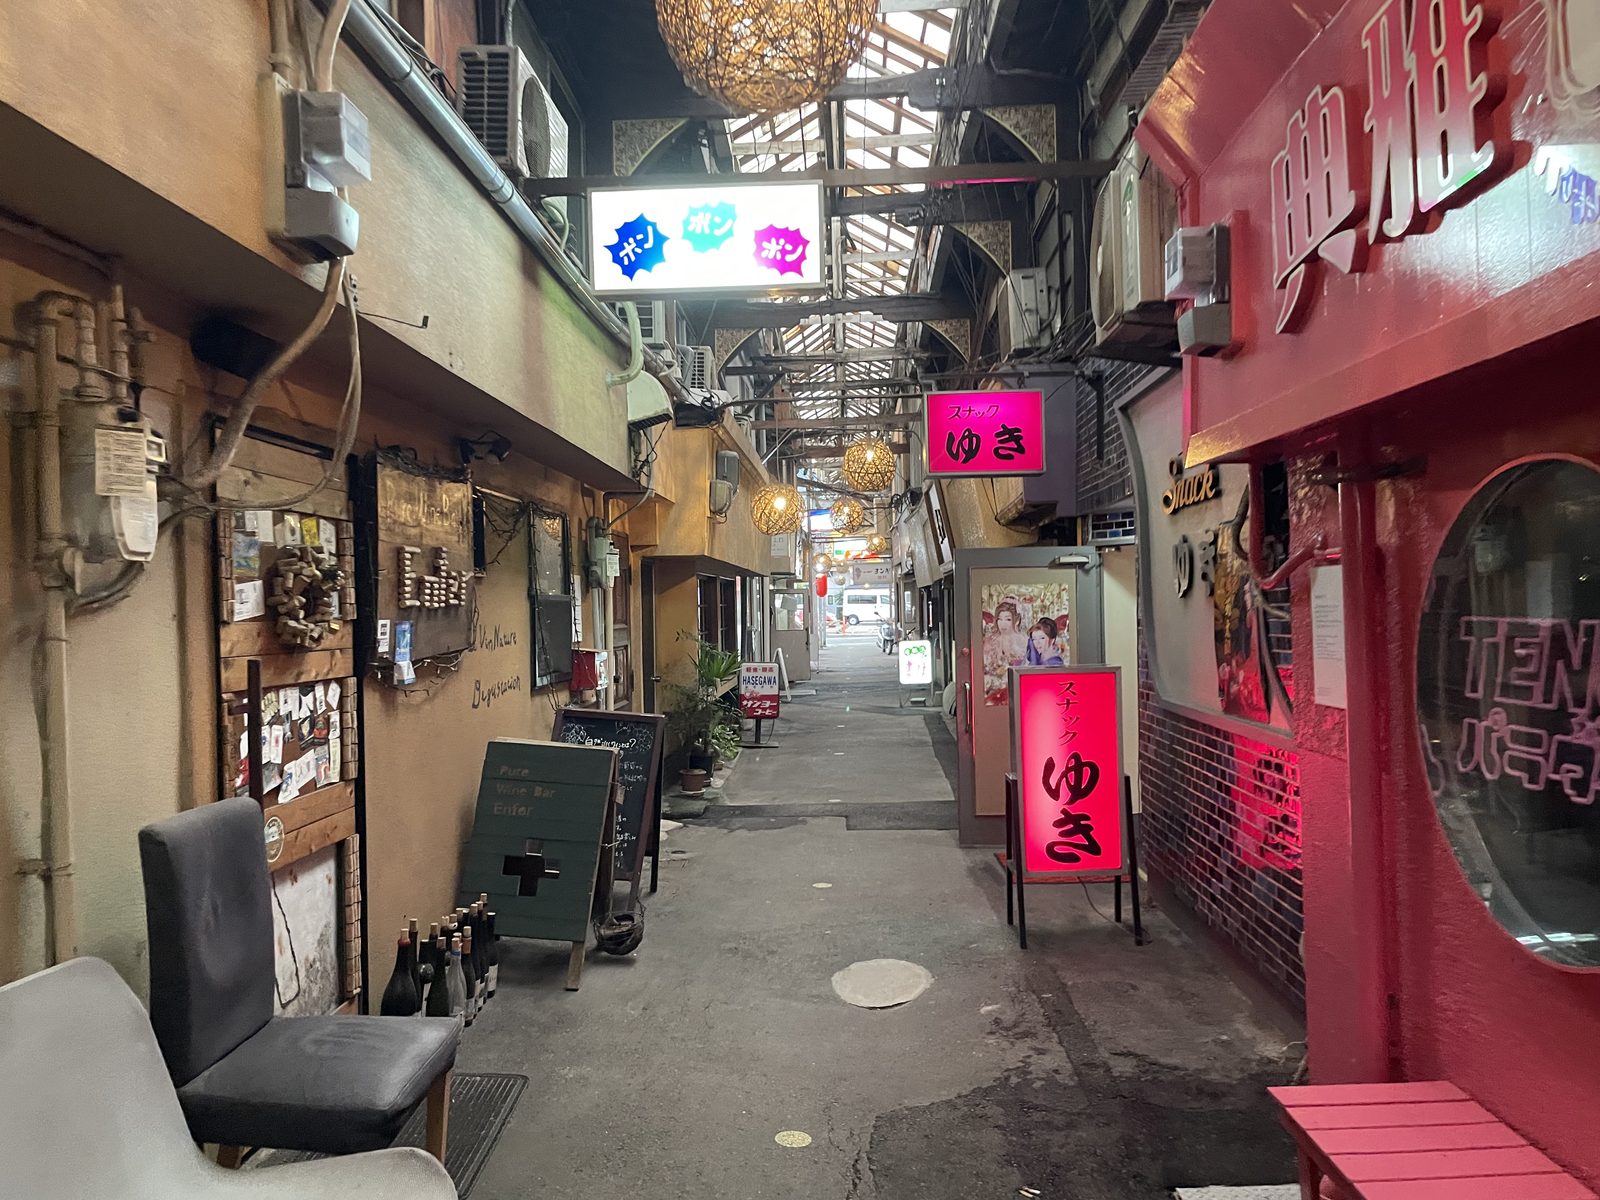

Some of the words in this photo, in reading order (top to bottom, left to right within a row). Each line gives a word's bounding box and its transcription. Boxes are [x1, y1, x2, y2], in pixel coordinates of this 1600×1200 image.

[619, 225, 655, 265] ポン
[687, 212, 734, 237] ポン
[760, 237, 804, 263] ポン
[948, 404, 1000, 420] スナック
[945, 424, 1026, 464] ゆき
[1162, 456, 1217, 516] Snack
[742, 675, 777, 686] HASEGAWA
[1458, 616, 1600, 713] TEN
[742, 700, 777, 708] サンヨー
[1056, 681, 1081, 746] スナック
[1041, 751, 1102, 864] ゆき
